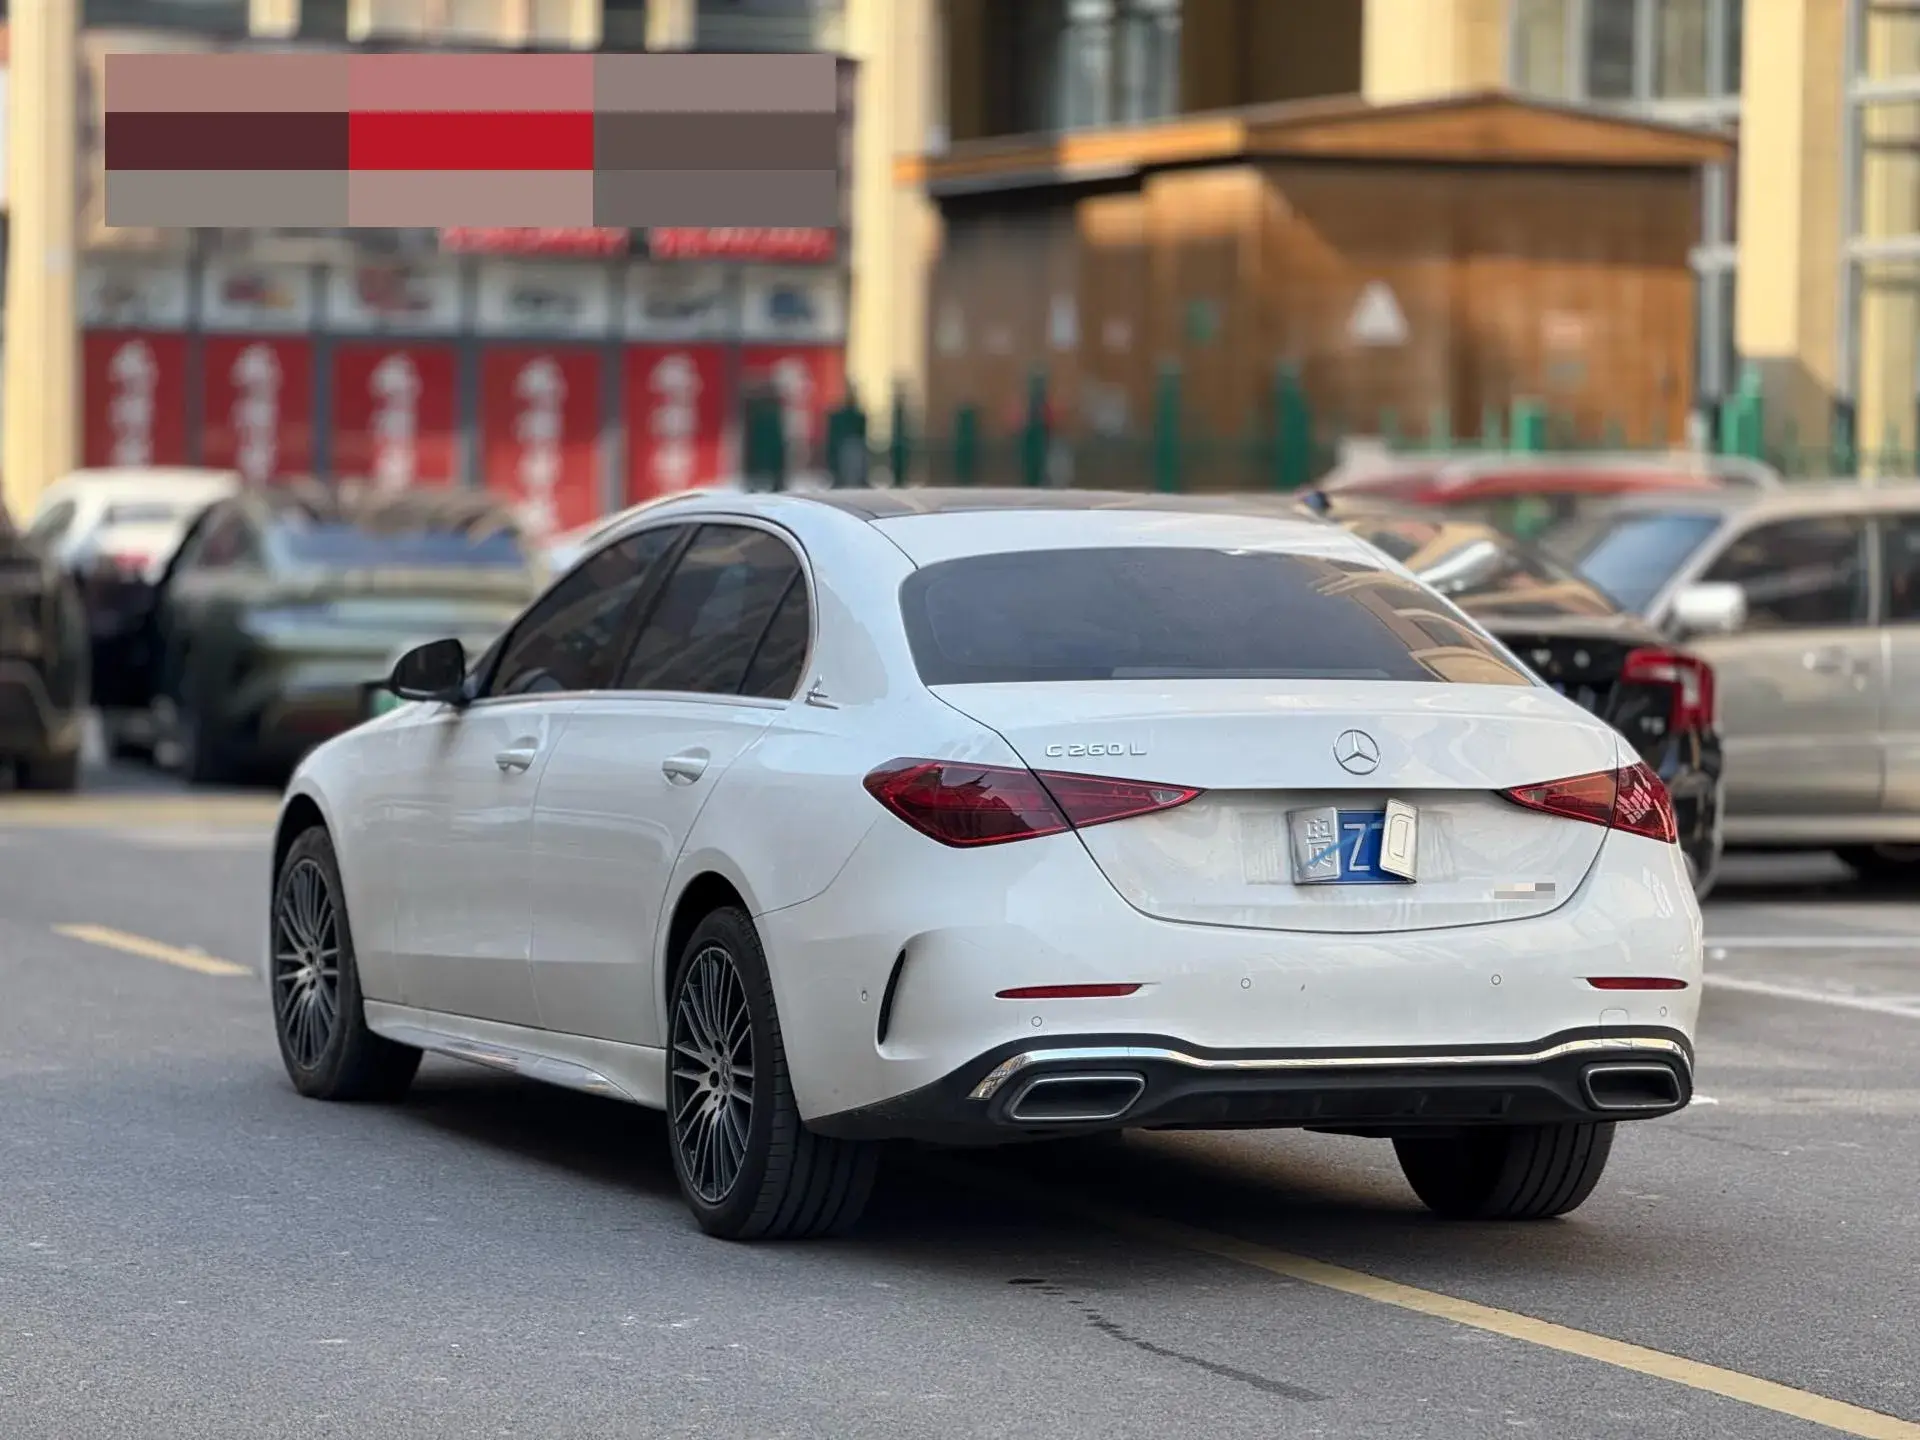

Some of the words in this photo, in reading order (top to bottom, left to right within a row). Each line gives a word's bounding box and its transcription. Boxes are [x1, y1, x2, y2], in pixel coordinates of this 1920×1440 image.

[1045, 743, 1063, 758] C
[1068, 742, 1125, 757] 260
[1130, 741, 1148, 756] L
